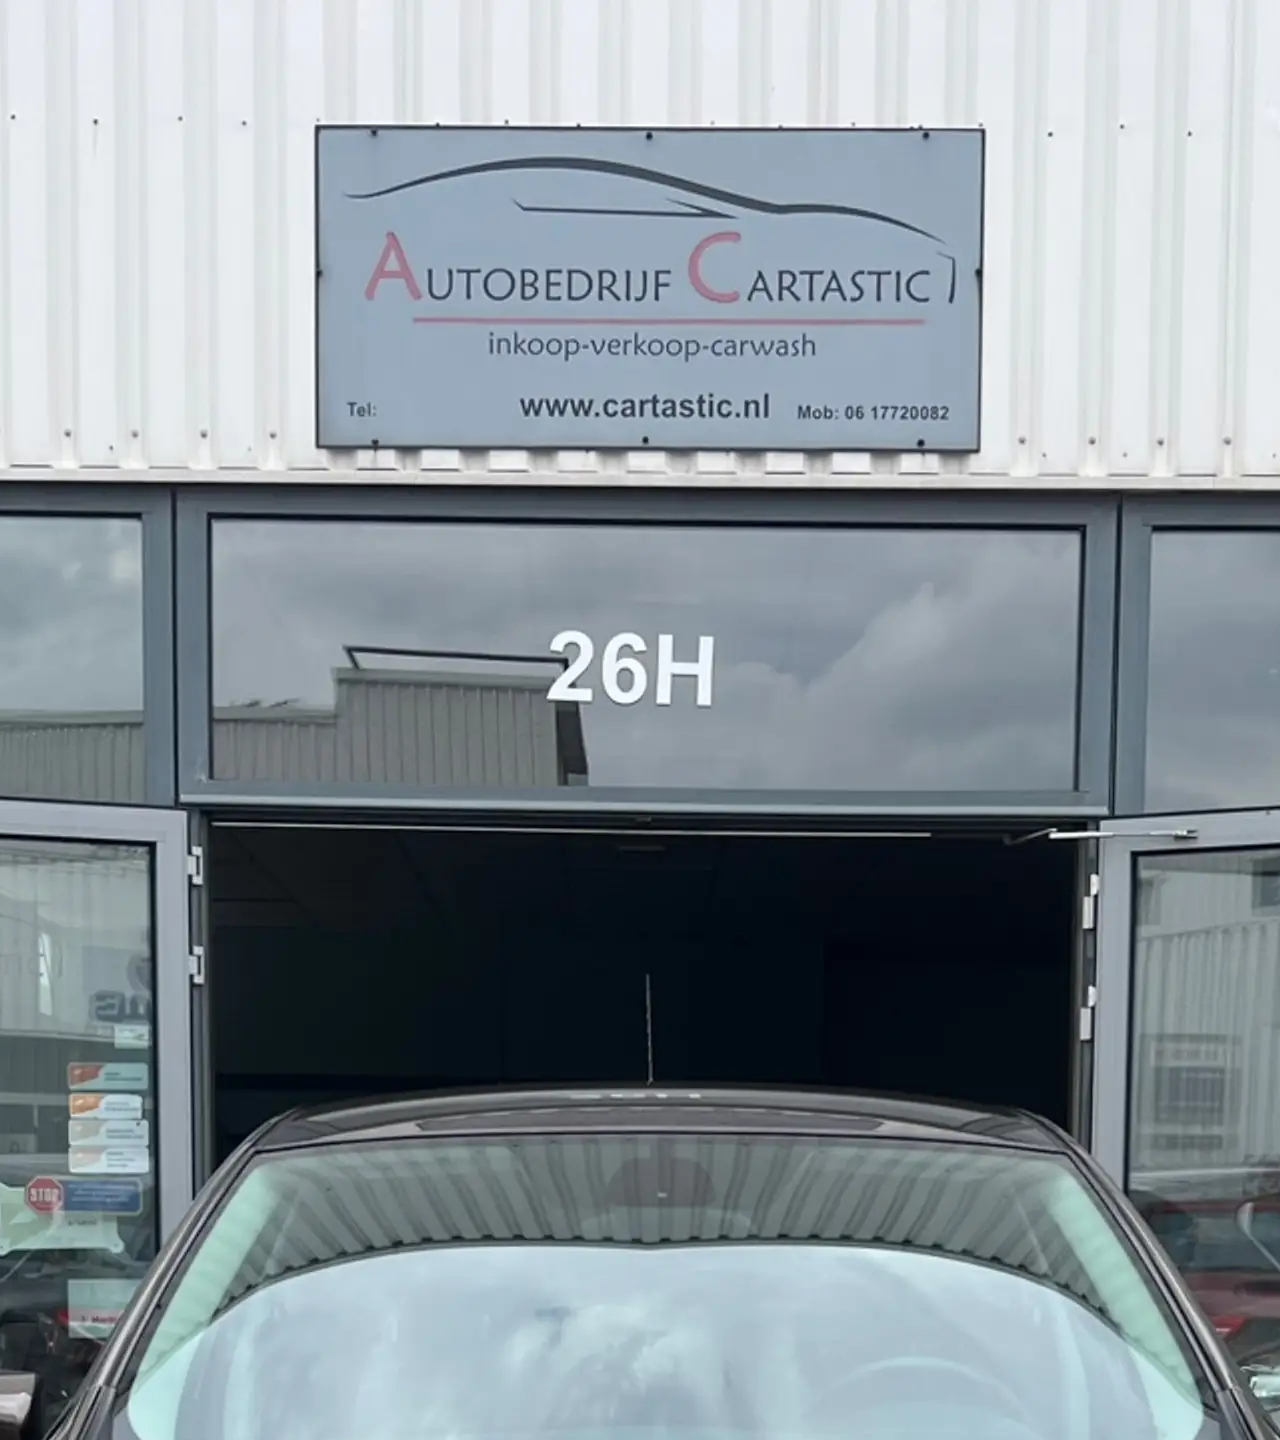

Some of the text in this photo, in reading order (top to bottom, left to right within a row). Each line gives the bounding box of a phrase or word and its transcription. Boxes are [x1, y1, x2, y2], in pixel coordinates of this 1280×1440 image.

[364, 231, 931, 303] AUTOBEDRIJF CARTASTIC
[488, 330, 817, 362] inkoop-verkoop-carwash
[347, 393, 950, 421] Tel: www.cartastic.nl Mob: 06 17720082
[547, 630, 714, 708] 26H
[30, 1187, 60, 1202] STOP
